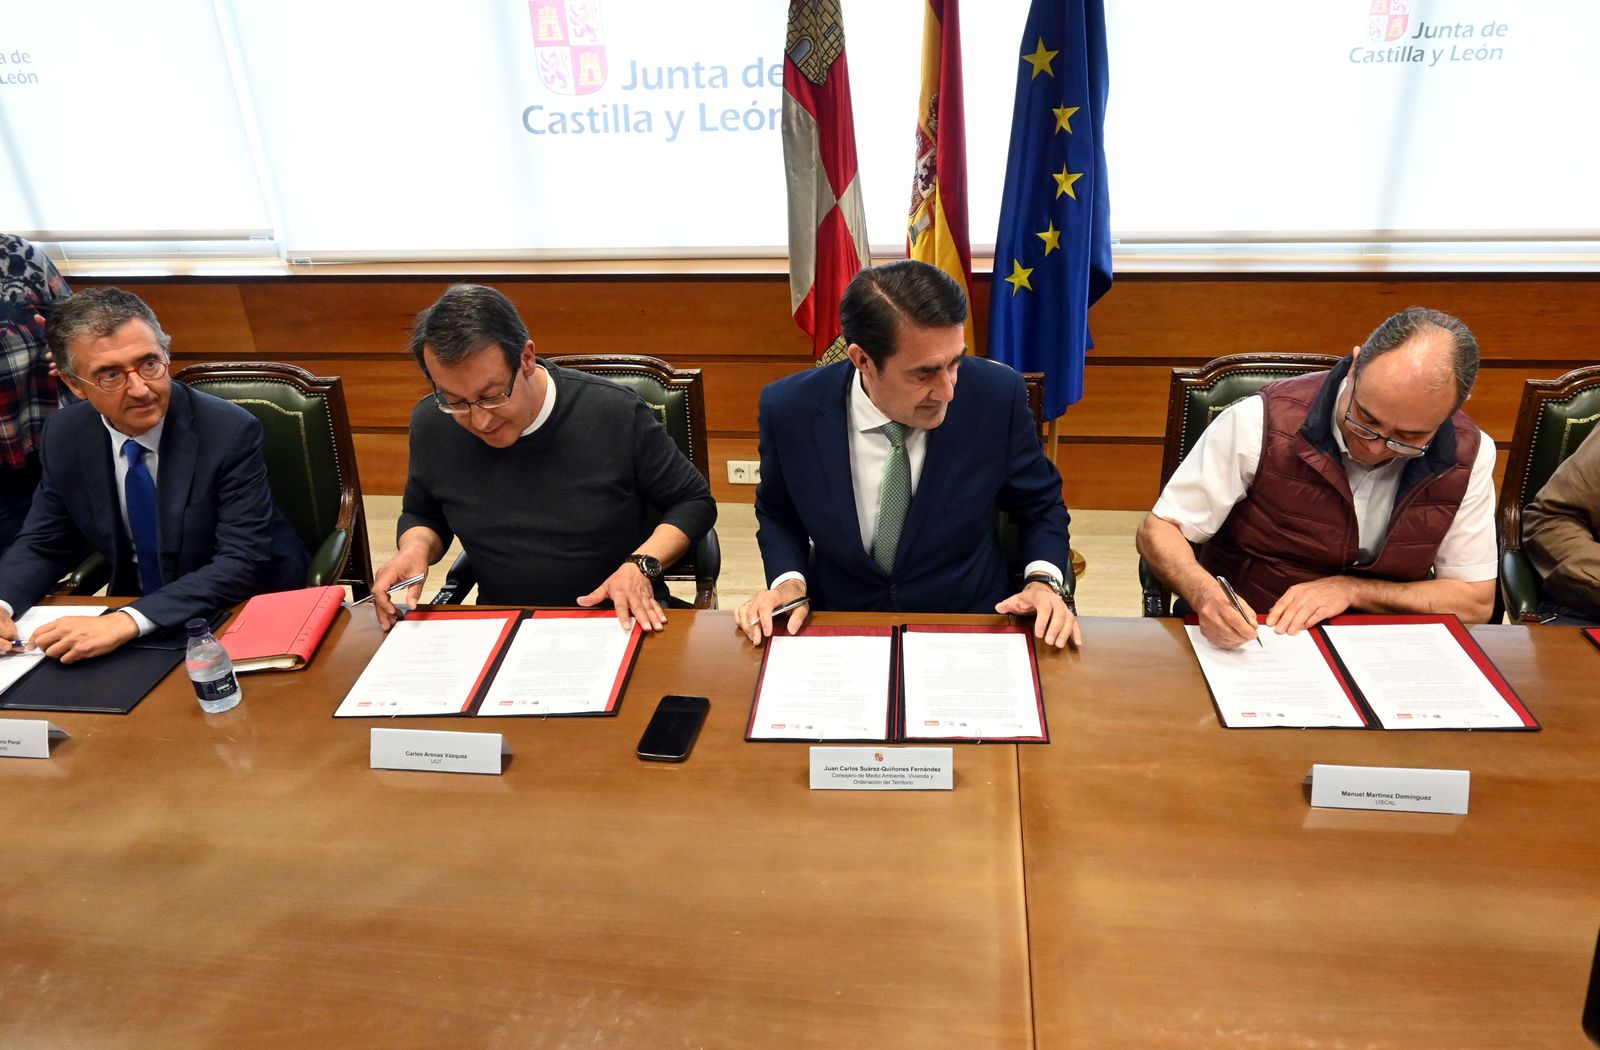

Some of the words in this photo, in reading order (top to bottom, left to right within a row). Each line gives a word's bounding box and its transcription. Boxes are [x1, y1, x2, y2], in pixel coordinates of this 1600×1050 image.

[1411, 22, 1474, 40] Junta
[1481, 20, 1509, 38] de
[10, 49, 31, 64] de
[1349, 46, 1425, 64] Castilla
[1428, 48, 1444, 68] y
[1449, 44, 1504, 62] León
[621, 60, 729, 91] Junta
[741, 57, 784, 89] de
[522, 103, 653, 135] Castilla
[664, 109, 685, 143] y
[405, 750, 423, 758] Carlos
[424, 751, 444, 759] Arenas
[1341, 790, 1365, 799] Manuel
